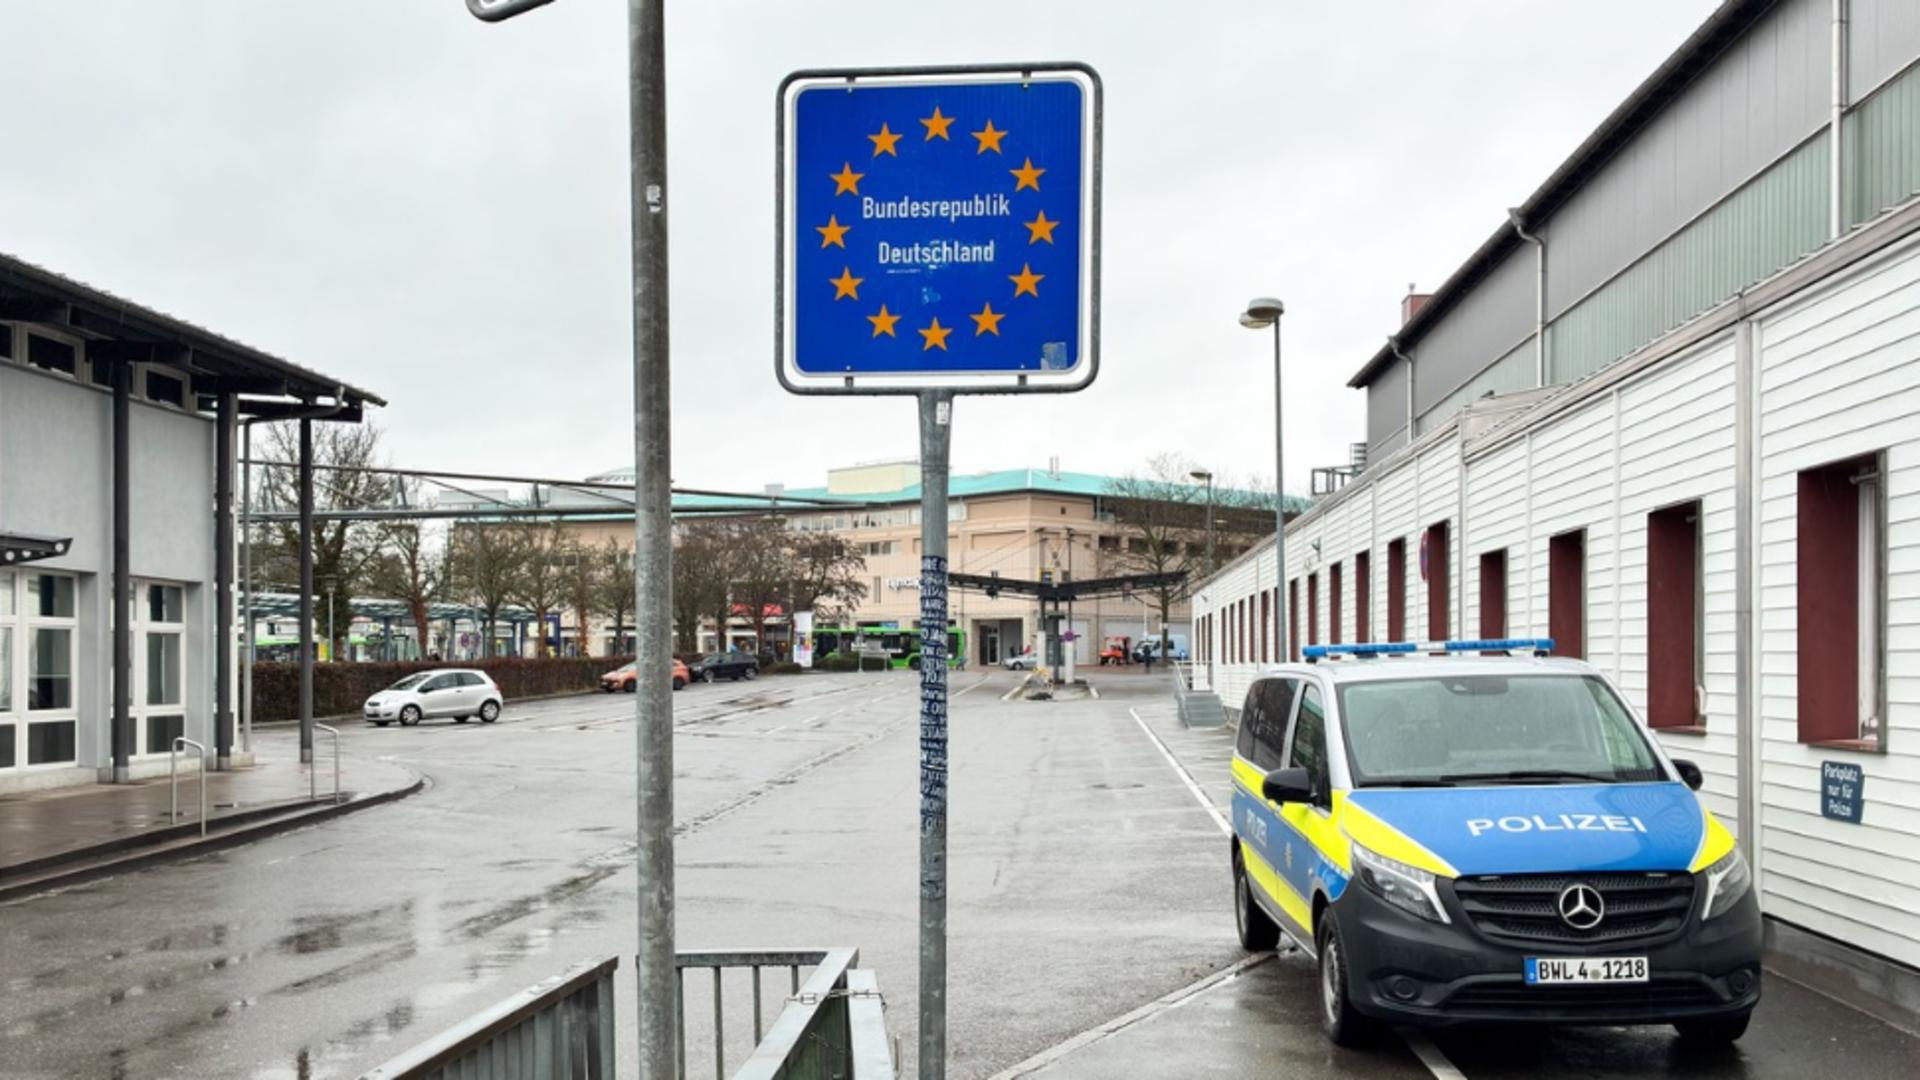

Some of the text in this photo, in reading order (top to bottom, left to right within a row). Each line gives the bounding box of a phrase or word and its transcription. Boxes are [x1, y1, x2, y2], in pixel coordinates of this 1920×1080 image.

[862, 193, 1010, 223] Bundesrepublik
[878, 239, 995, 265] Deutschland
[1824, 763, 1858, 782] Parkplatz
[1828, 785, 1840, 797] nur
[1466, 814, 1648, 837] POLIZEI
[1538, 961, 1574, 980] BWL
[1577, 961, 1588, 980] 4
[1602, 959, 1646, 980] 1218
